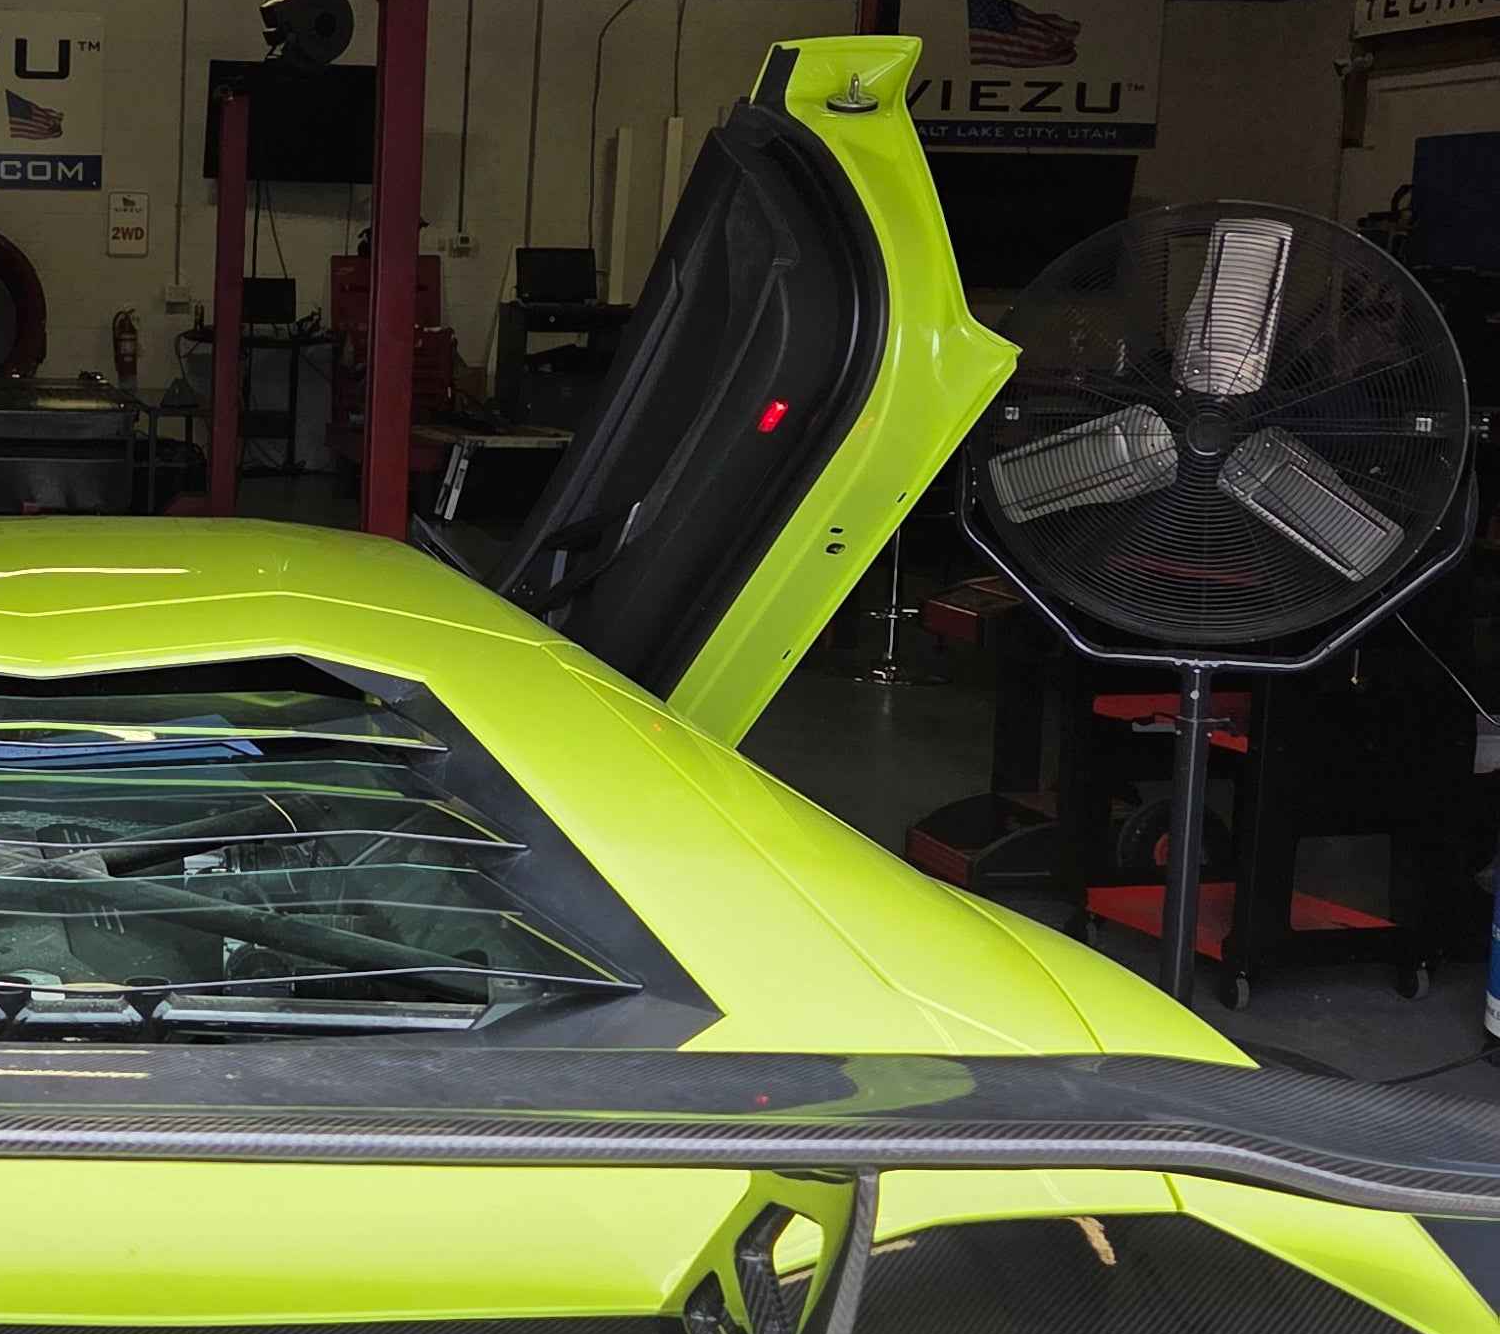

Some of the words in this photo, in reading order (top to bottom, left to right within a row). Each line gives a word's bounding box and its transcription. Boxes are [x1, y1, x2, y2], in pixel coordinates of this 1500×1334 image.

[917, 125, 949, 139] ALT
[956, 126, 1004, 139] LAKE
[1067, 128, 1117, 140] UTAH
[111, 226, 145, 241] 2WD
